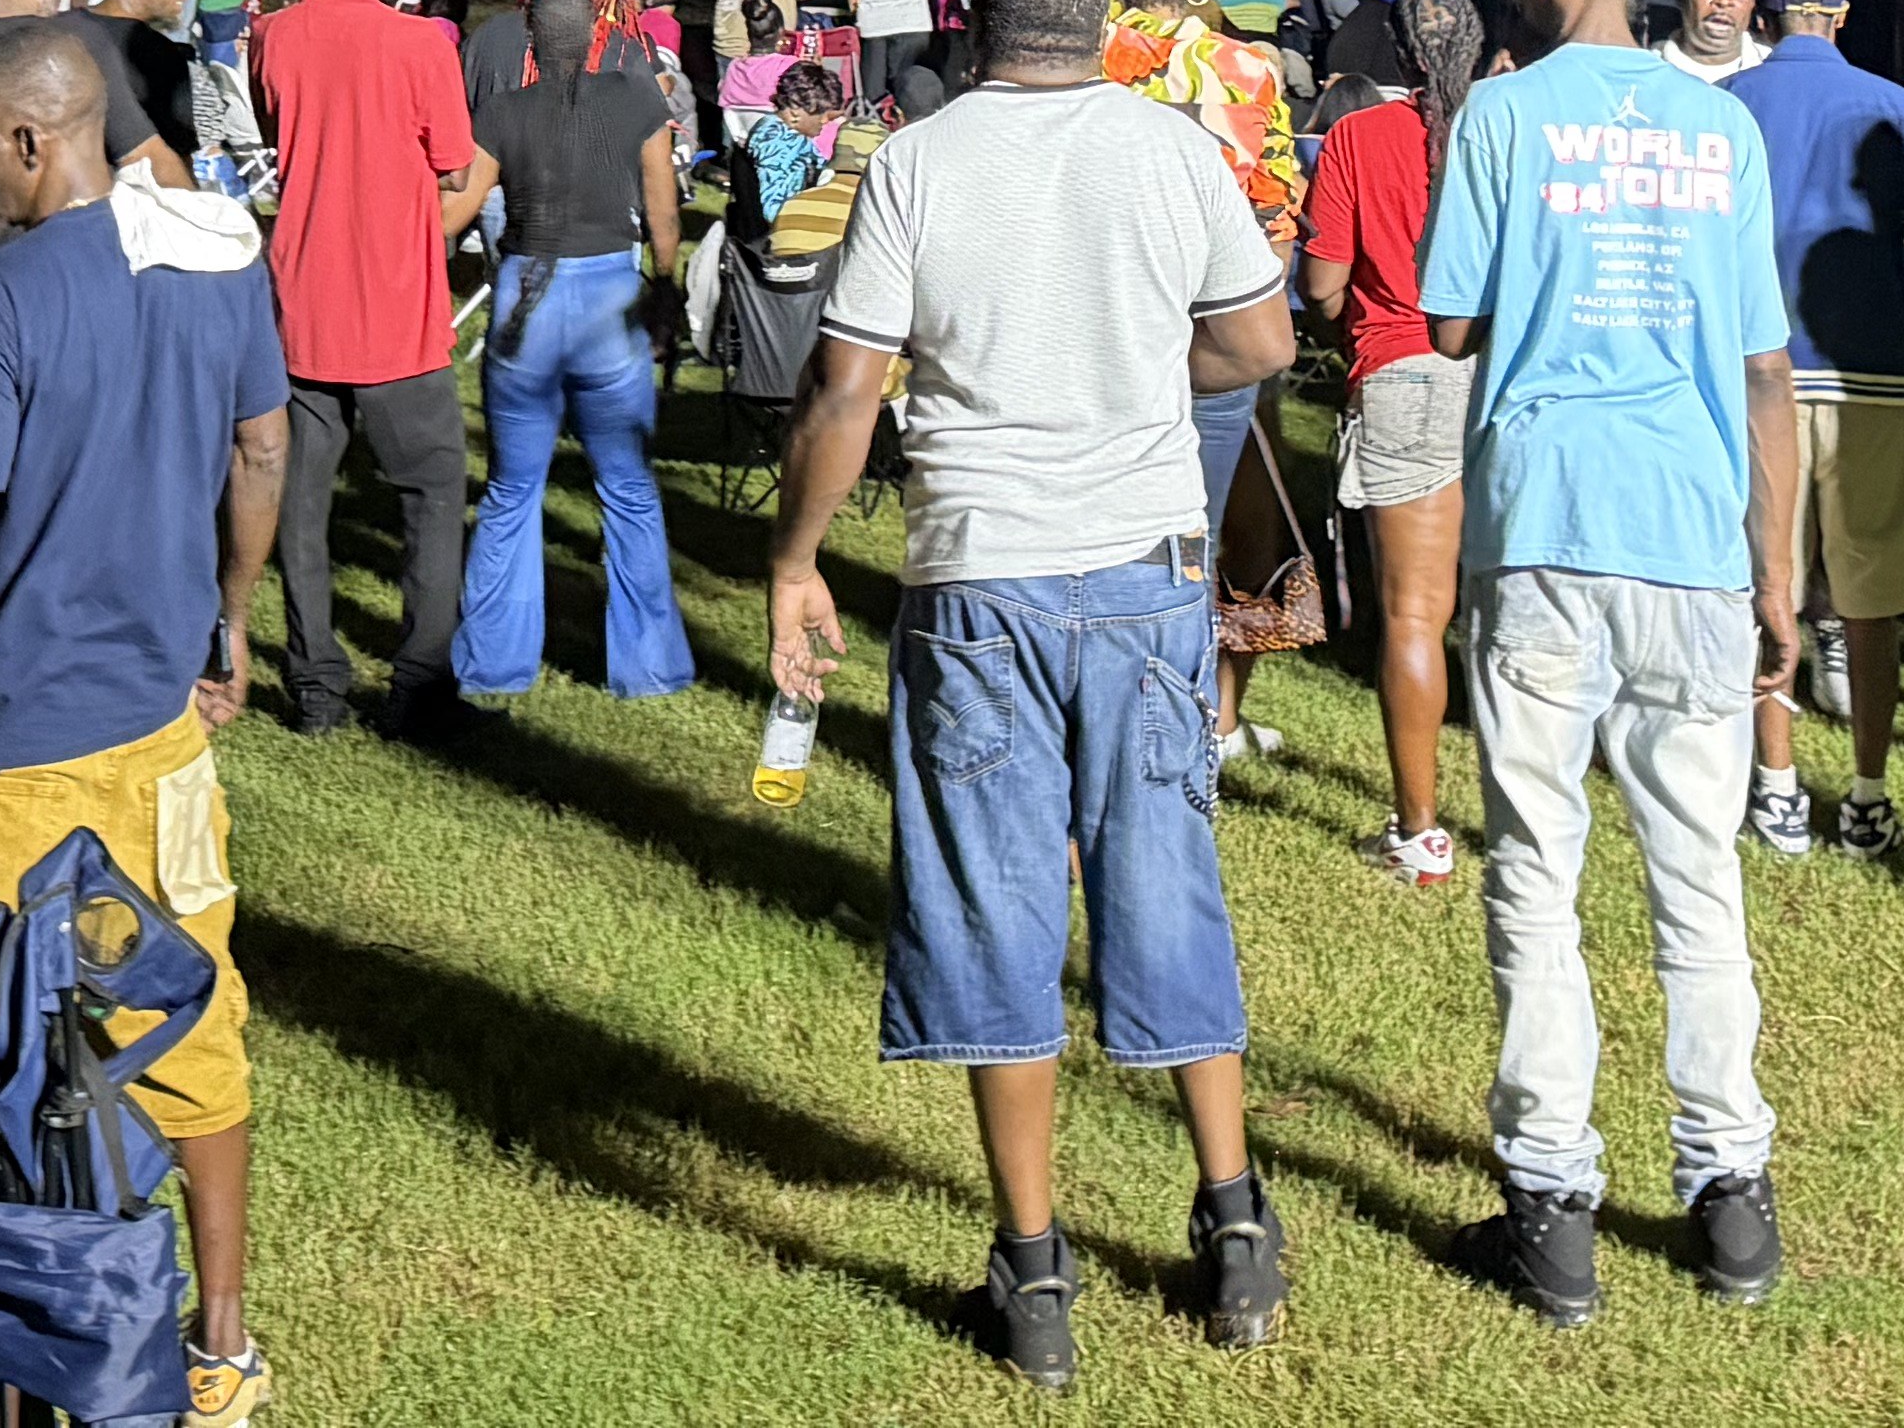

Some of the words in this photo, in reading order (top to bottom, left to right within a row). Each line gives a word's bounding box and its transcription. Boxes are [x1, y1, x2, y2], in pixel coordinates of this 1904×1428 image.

[1541, 123, 1731, 172] WORLD
[1600, 165, 1732, 216] TOUR
[1671, 226, 1691, 239] CA
[1661, 245, 1683, 257] OR
[1654, 263, 1674, 274] AZ
[1653, 281, 1675, 293] WA
